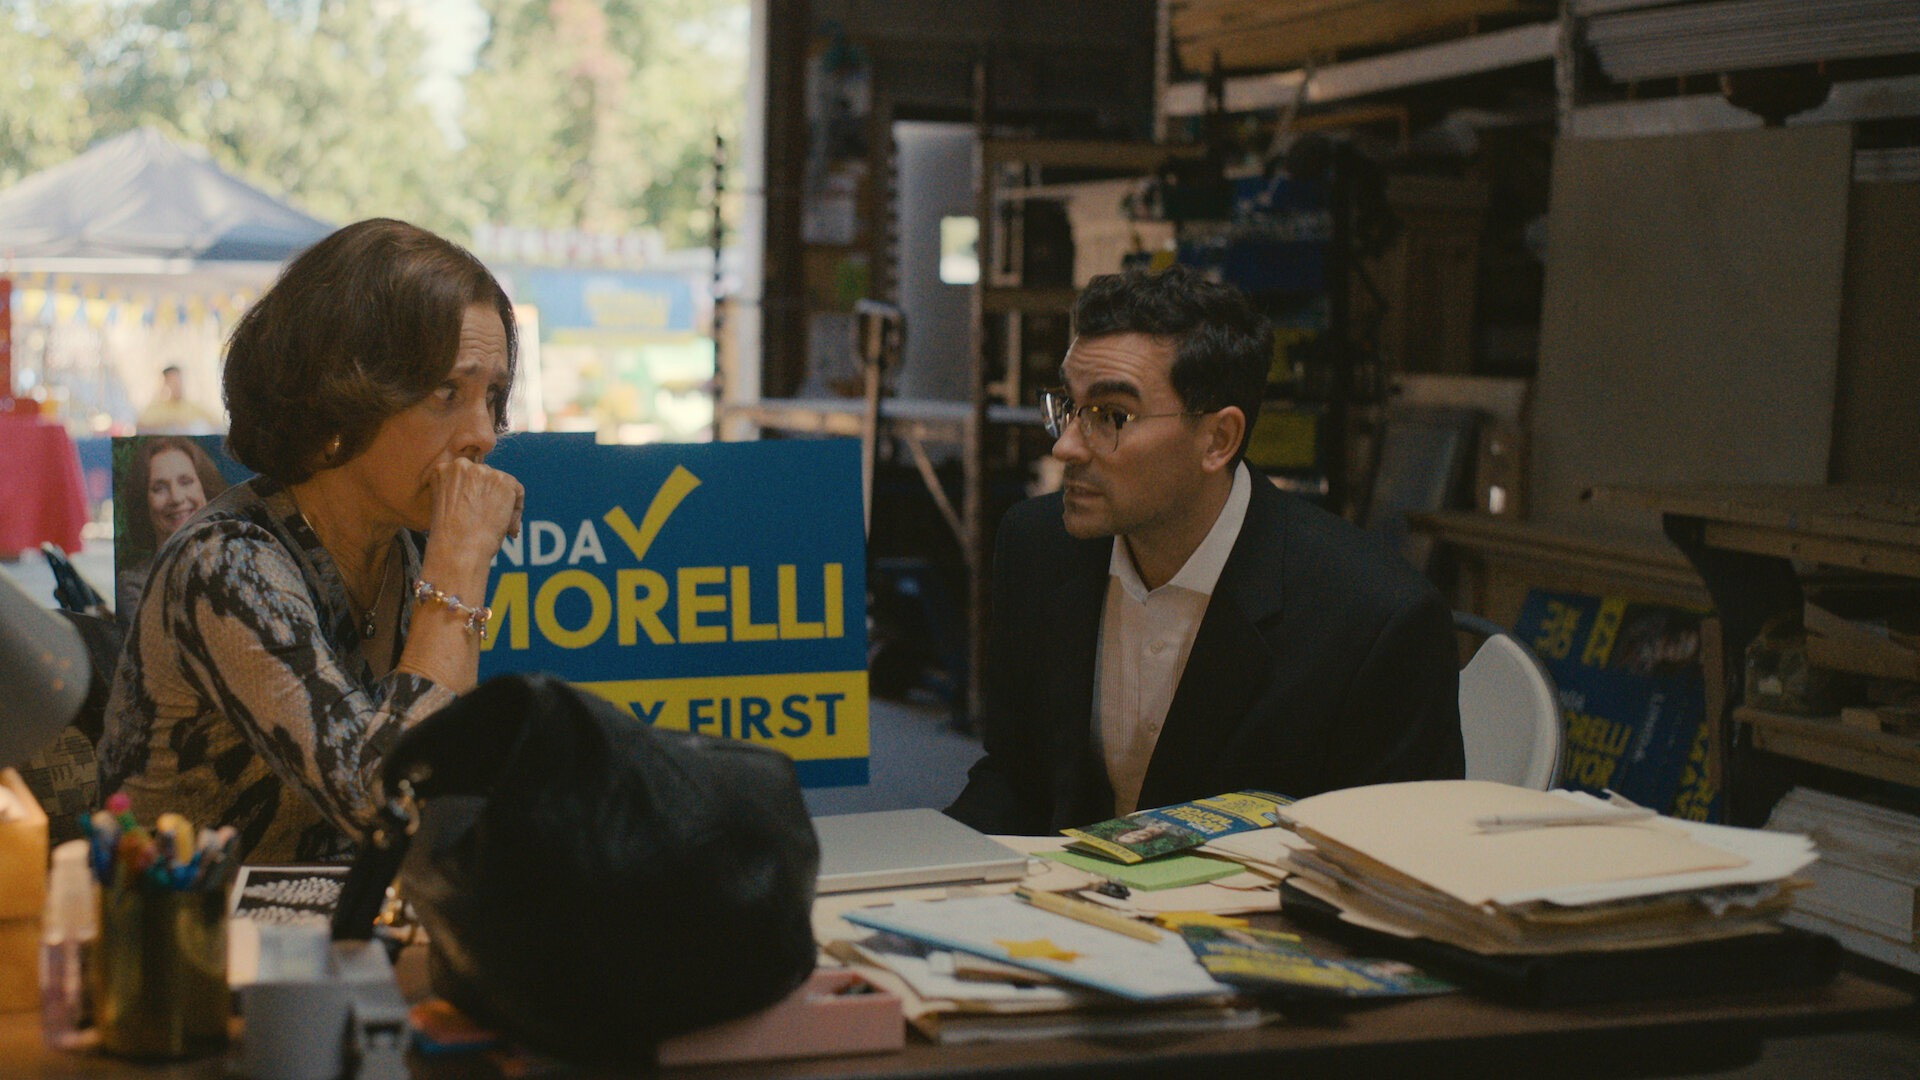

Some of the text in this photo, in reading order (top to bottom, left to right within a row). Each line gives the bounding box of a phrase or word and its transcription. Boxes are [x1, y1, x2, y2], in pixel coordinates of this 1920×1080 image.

[490, 518, 608, 568] NDA
[479, 562, 845, 651] MORELLI
[688, 693, 845, 739] FIRST
